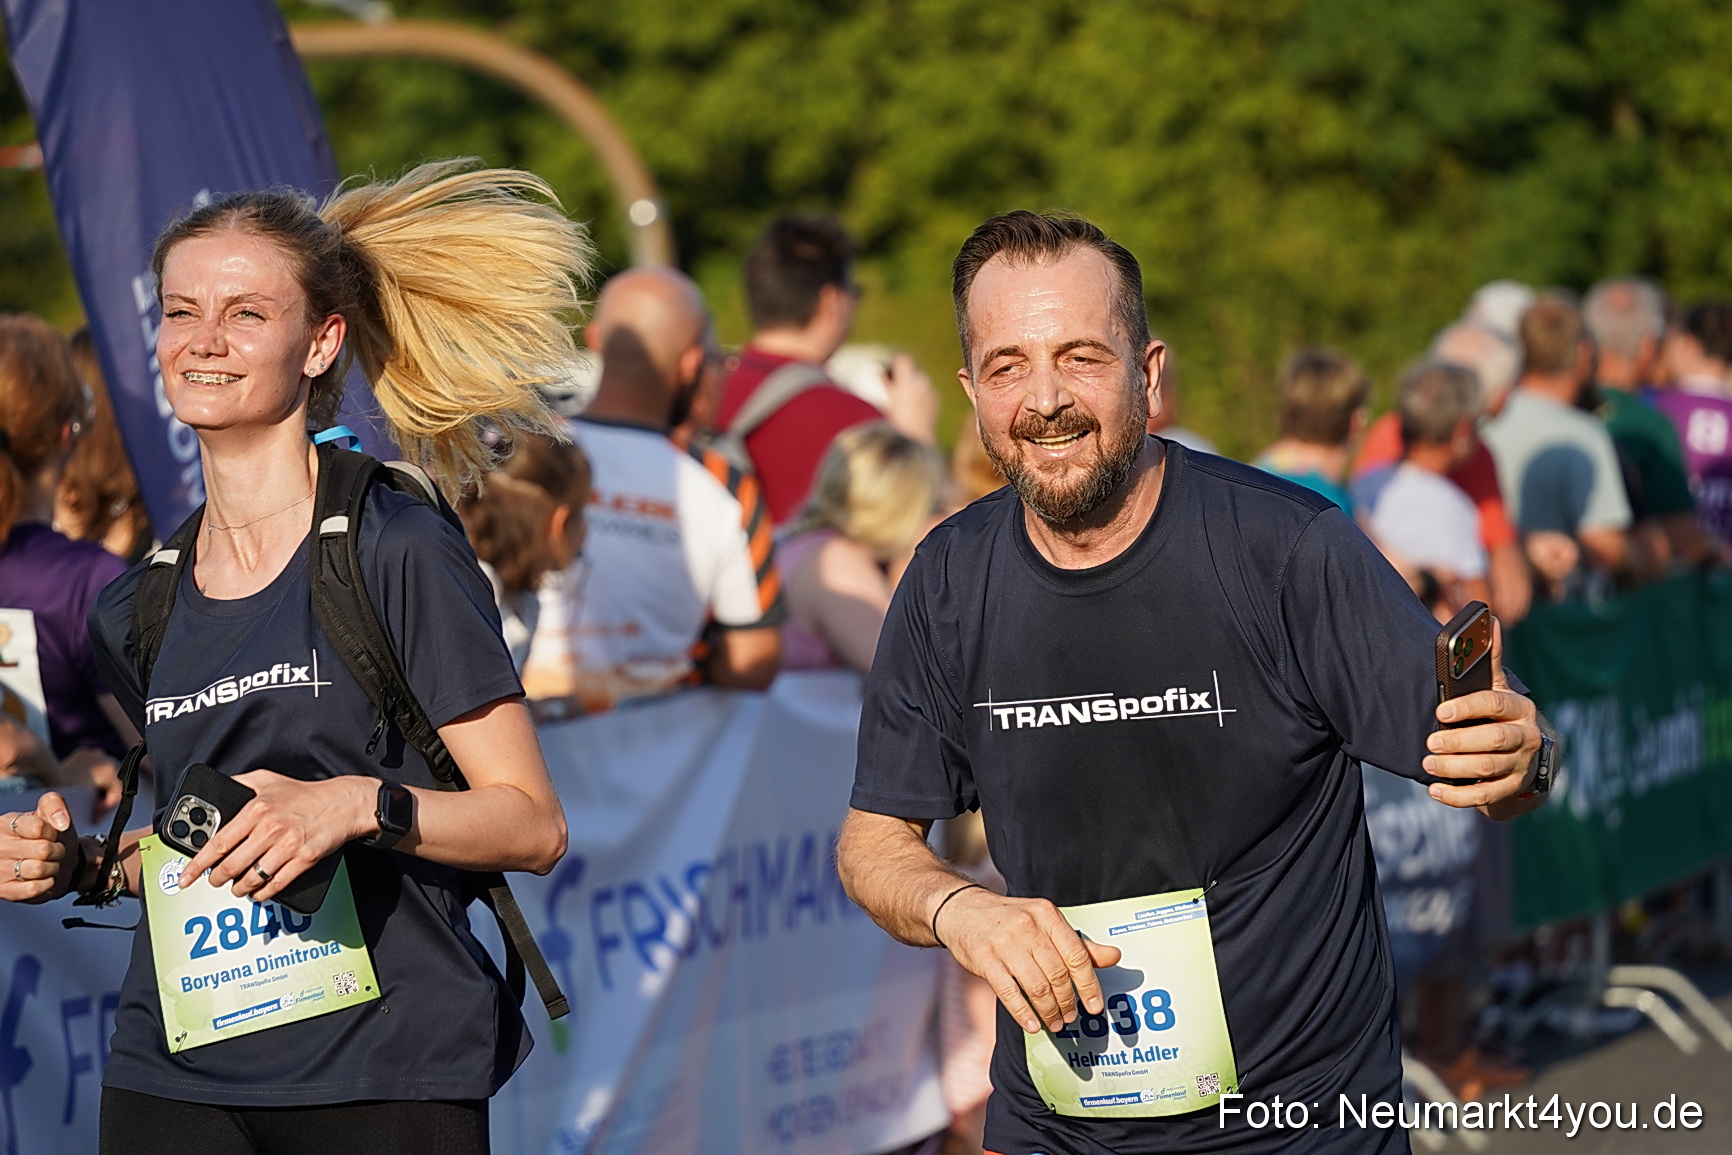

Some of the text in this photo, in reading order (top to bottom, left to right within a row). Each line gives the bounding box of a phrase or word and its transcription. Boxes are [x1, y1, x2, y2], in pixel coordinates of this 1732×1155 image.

[145, 662, 310, 726] TRANSpofix
[993, 687, 1212, 730] TRANSpofix
[180, 940, 342, 994] Boryana Dimitrova
[271, 973, 288, 984] GmbH
[215, 1002, 278, 1029] firmenlauf.bayern
[1068, 1045, 1179, 1068] Helmut Adler
[1101, 1068, 1149, 1078] TRANSpofix GmbH
[1083, 1095, 1138, 1107] firmenlauf.bayern
[1156, 1089, 1187, 1100] Firmenlauf
